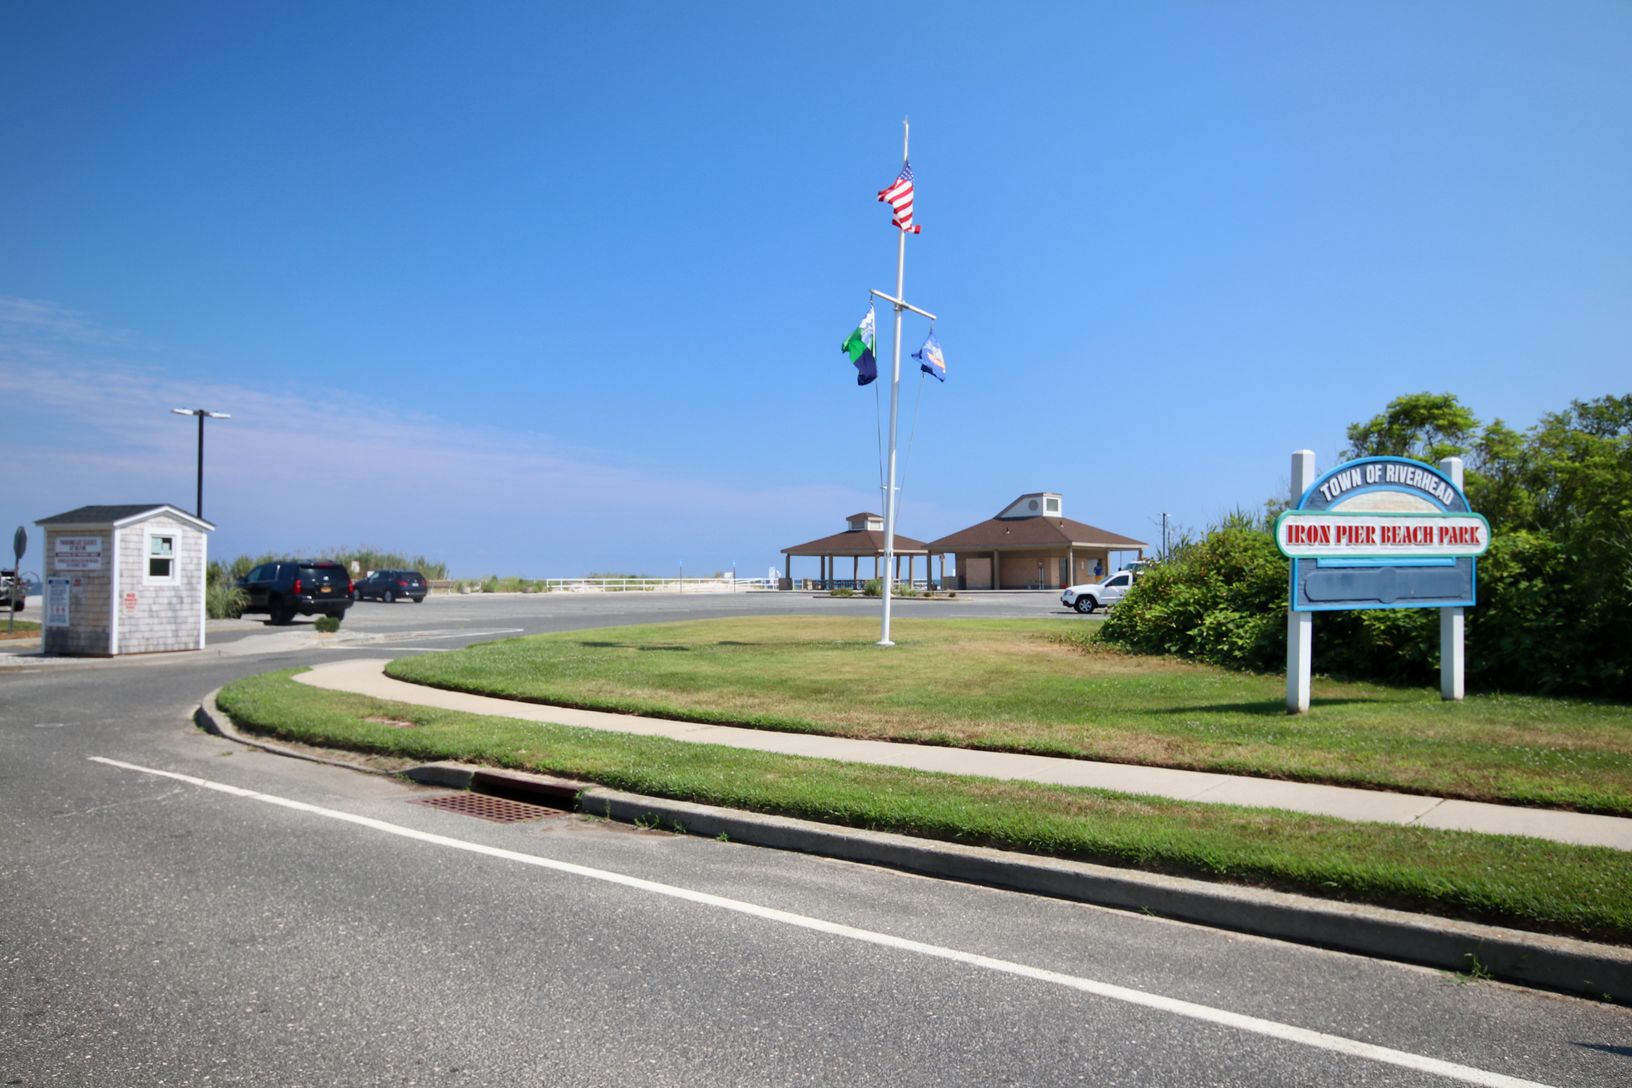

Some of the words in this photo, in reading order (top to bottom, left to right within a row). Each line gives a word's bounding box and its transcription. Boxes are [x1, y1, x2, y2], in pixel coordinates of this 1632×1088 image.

[1320, 468, 1362, 502] TOWN
[1366, 464, 1383, 484] OF
[1385, 464, 1454, 505] RIVERHEAD
[1287, 525, 1331, 545] IRON
[1335, 525, 1376, 545] PIER
[1380, 525, 1434, 545] BEACH
[1438, 525, 1481, 545] PARK
